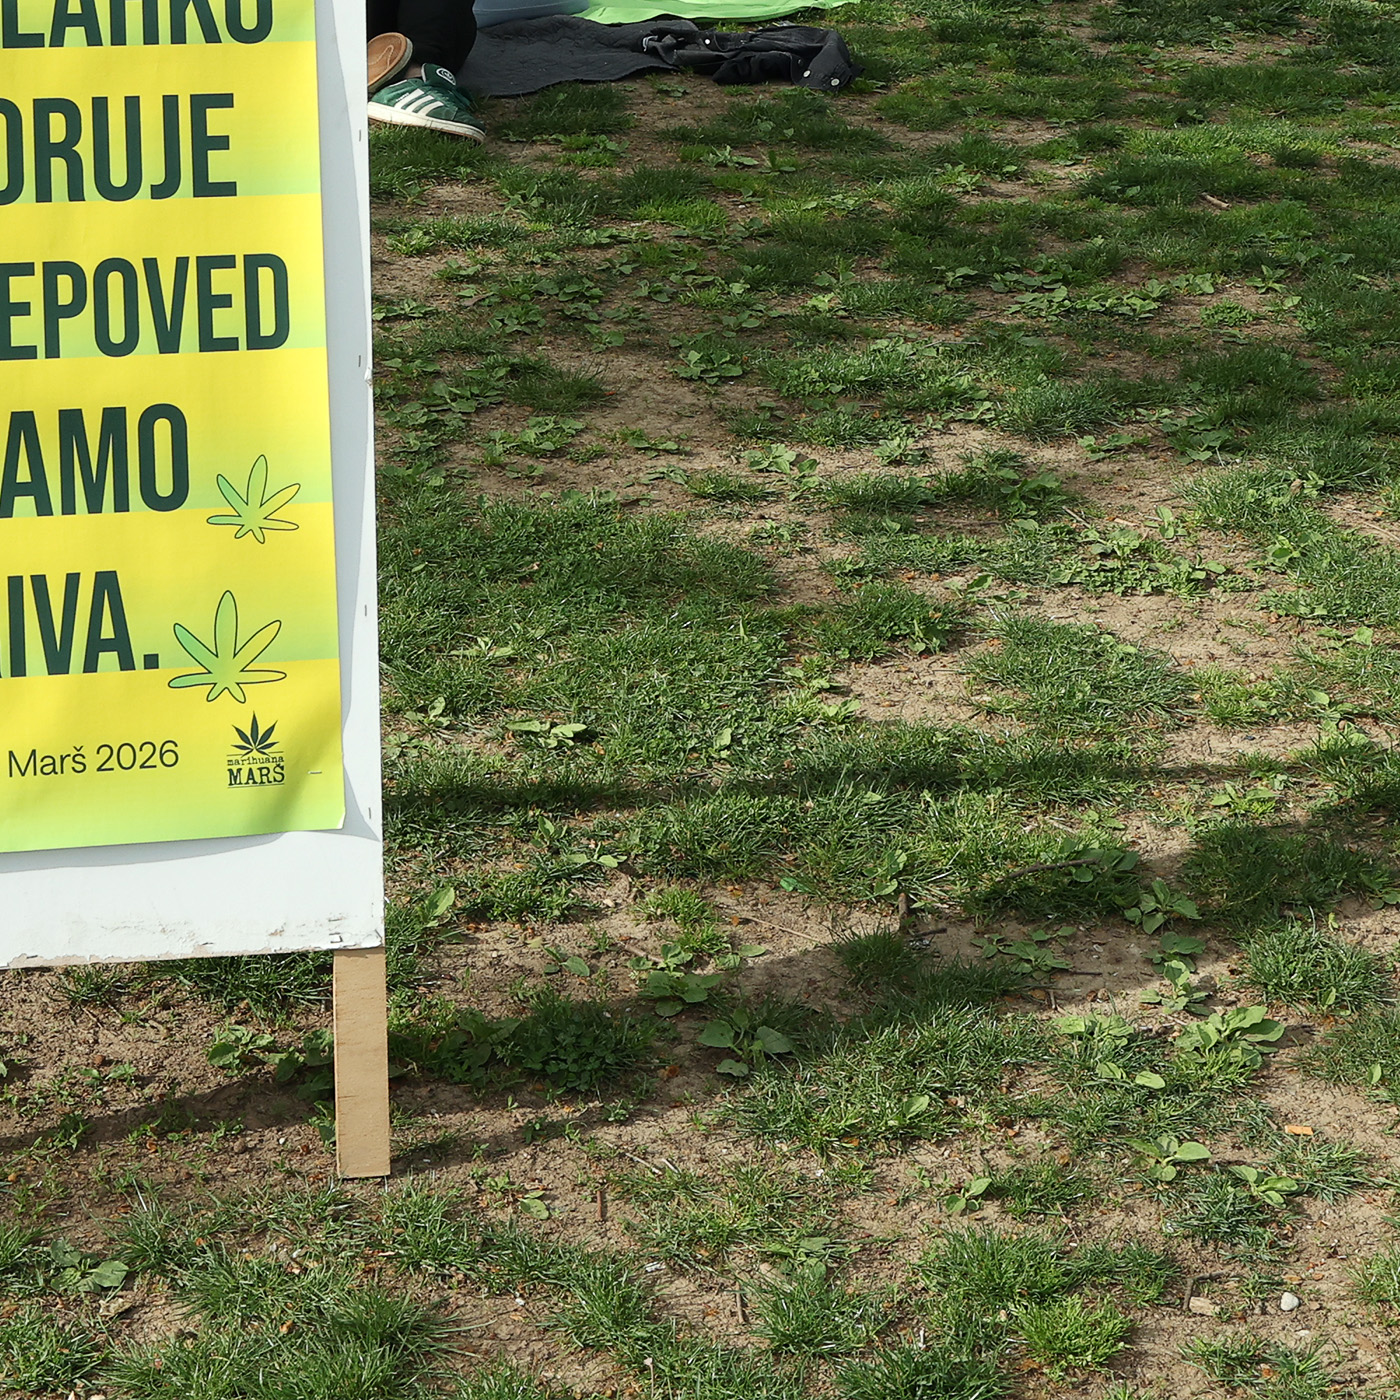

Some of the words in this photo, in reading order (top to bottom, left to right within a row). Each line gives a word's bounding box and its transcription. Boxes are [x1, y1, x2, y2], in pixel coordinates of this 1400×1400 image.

[8, 746, 87, 778] Marš
[96, 740, 179, 772] 2026
[227, 755, 285, 766] marihuana
[227, 763, 285, 786] MARŠ
